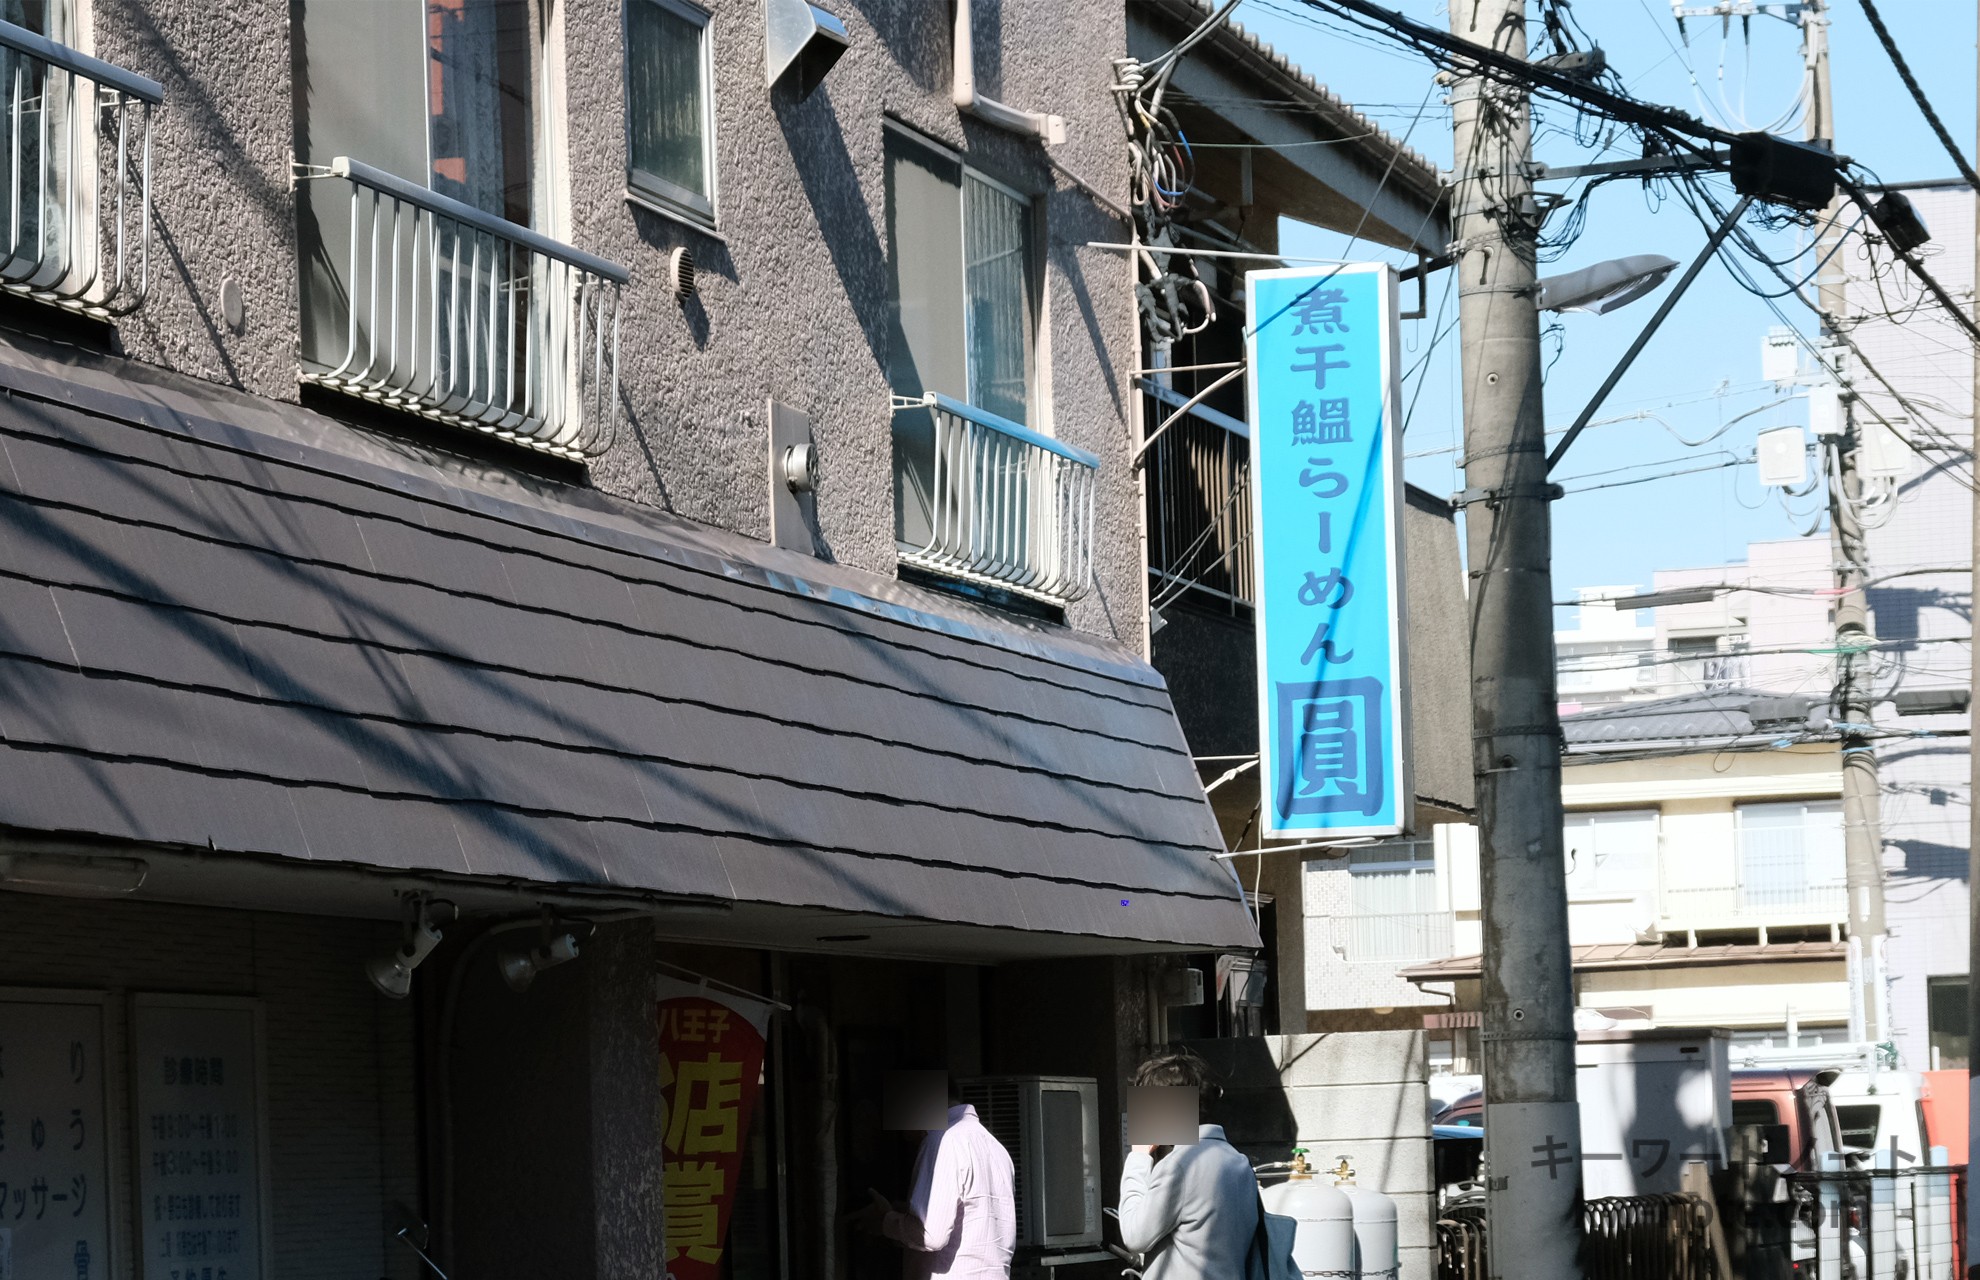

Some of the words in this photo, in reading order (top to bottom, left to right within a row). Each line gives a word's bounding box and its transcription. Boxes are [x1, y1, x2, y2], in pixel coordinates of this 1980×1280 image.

[1275, 675, 1384, 820] 圓
[659, 1008, 731, 1043] 八王子
